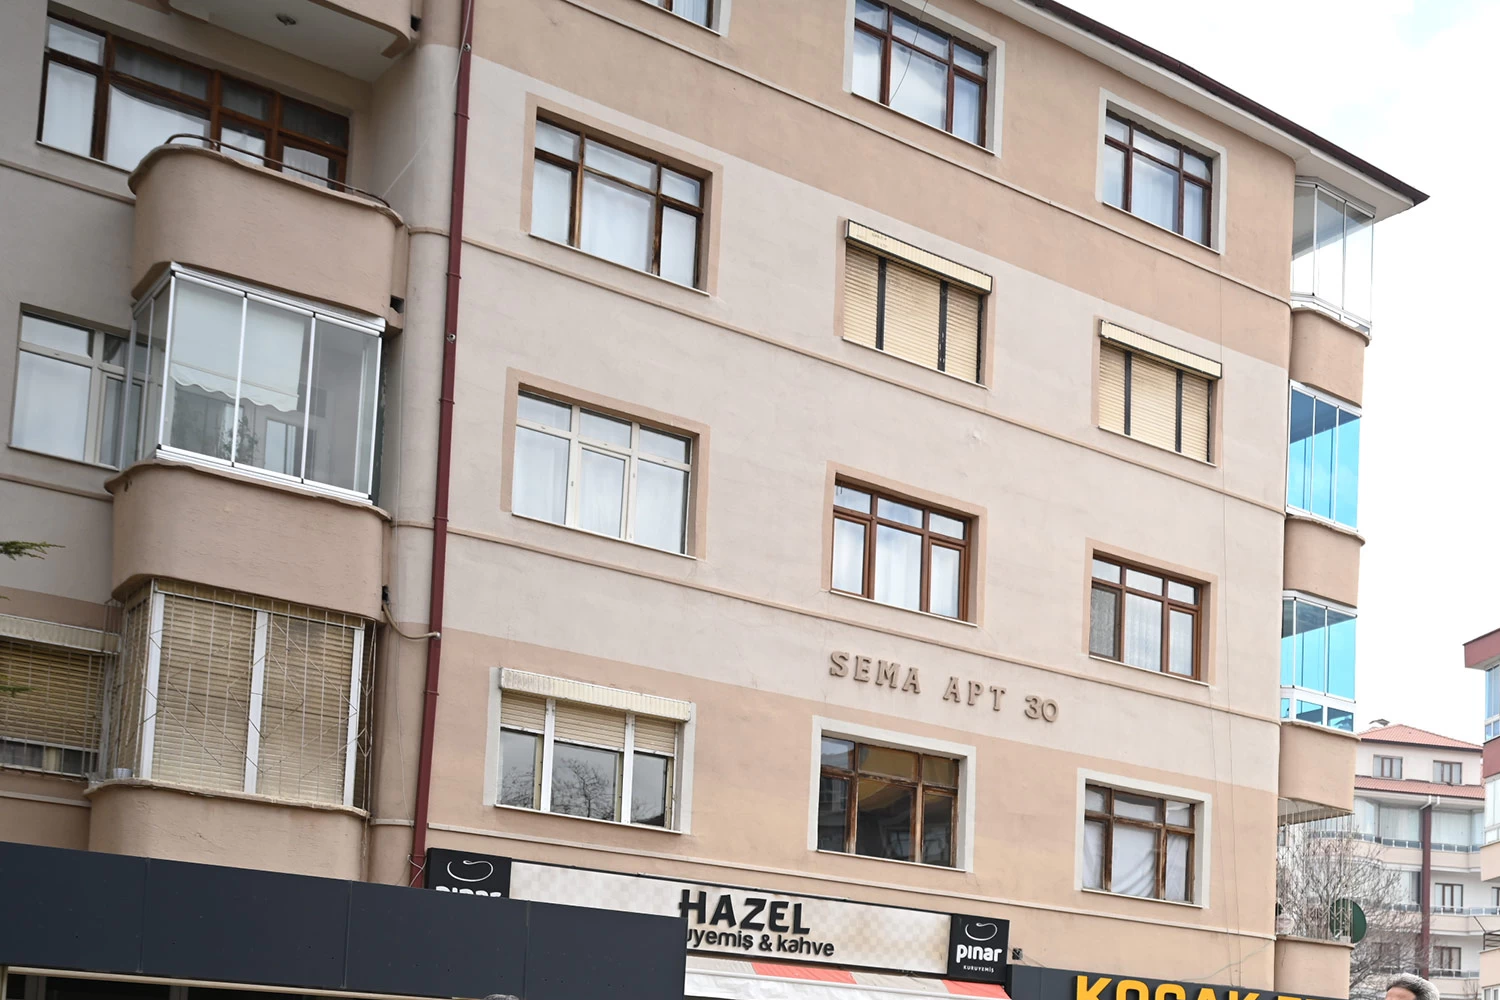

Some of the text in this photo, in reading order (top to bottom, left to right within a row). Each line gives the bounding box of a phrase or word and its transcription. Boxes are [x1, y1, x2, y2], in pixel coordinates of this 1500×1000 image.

[829, 651, 1059, 723] SEMA APT 30
[679, 888, 811, 935] HAZEL
[758, 933, 773, 952] &
[776, 934, 835, 957] kahve
